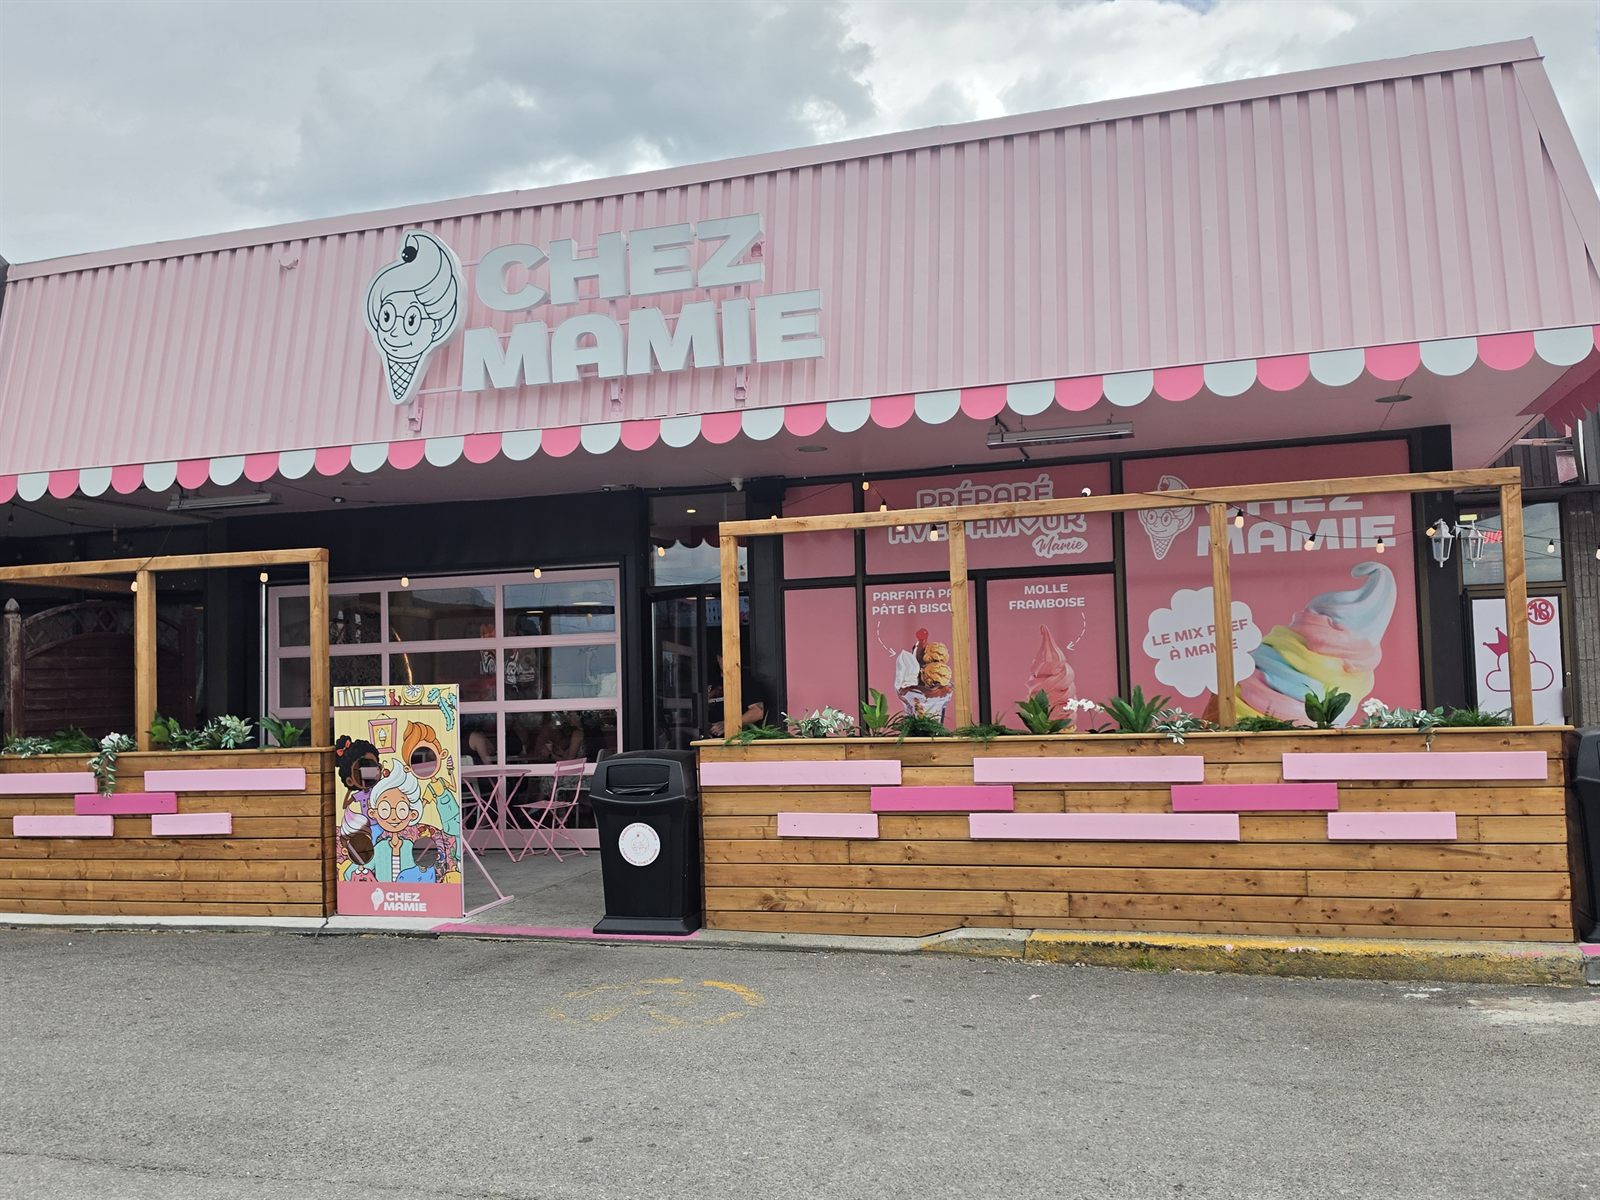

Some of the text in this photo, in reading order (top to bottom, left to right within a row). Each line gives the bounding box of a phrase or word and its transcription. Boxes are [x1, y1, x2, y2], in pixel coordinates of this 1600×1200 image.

[475, 213, 765, 312] CHEZ
[461, 288, 825, 392] MAMIE
[1197, 515, 1396, 557] MAMIE
[1035, 536, 1085, 555] Mamie
[1024, 583, 1068, 595] MOLLE
[872, 603, 905, 616] PÂTE
[908, 602, 916, 614] À
[1009, 597, 1085, 610] FRAMBOISE
[1152, 618, 1248, 646] LE MIX PEF
[1169, 645, 1181, 660] À
[385, 892, 420, 902] CHEZ
[383, 901, 427, 912] MAMIE
